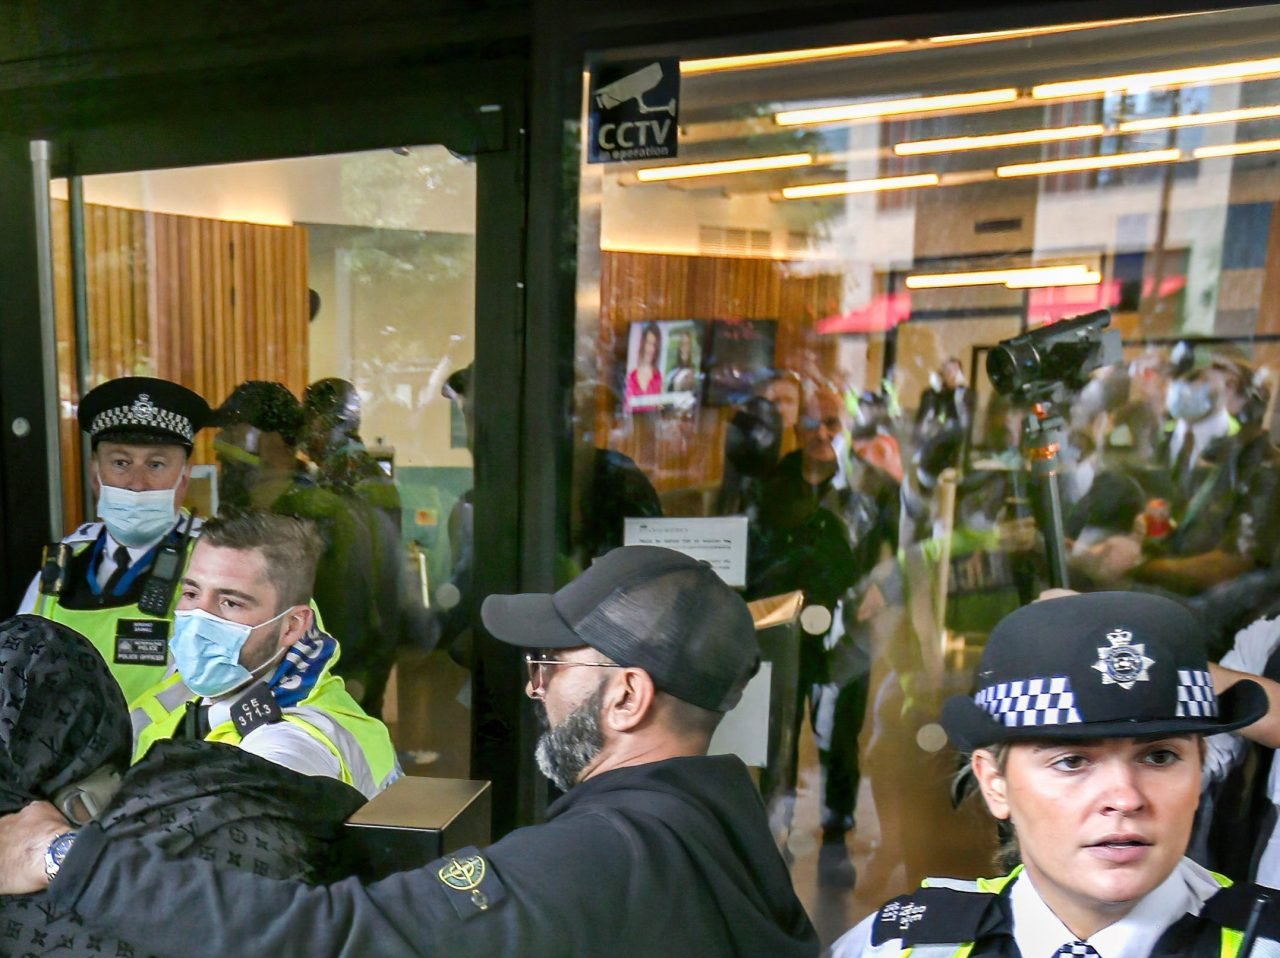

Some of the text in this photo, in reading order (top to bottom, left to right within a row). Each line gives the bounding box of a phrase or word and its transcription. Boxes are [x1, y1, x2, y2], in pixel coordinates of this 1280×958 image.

[599, 119, 672, 149] CCTV
[238, 704, 272, 727] 3713
[241, 698, 260, 711] CE
